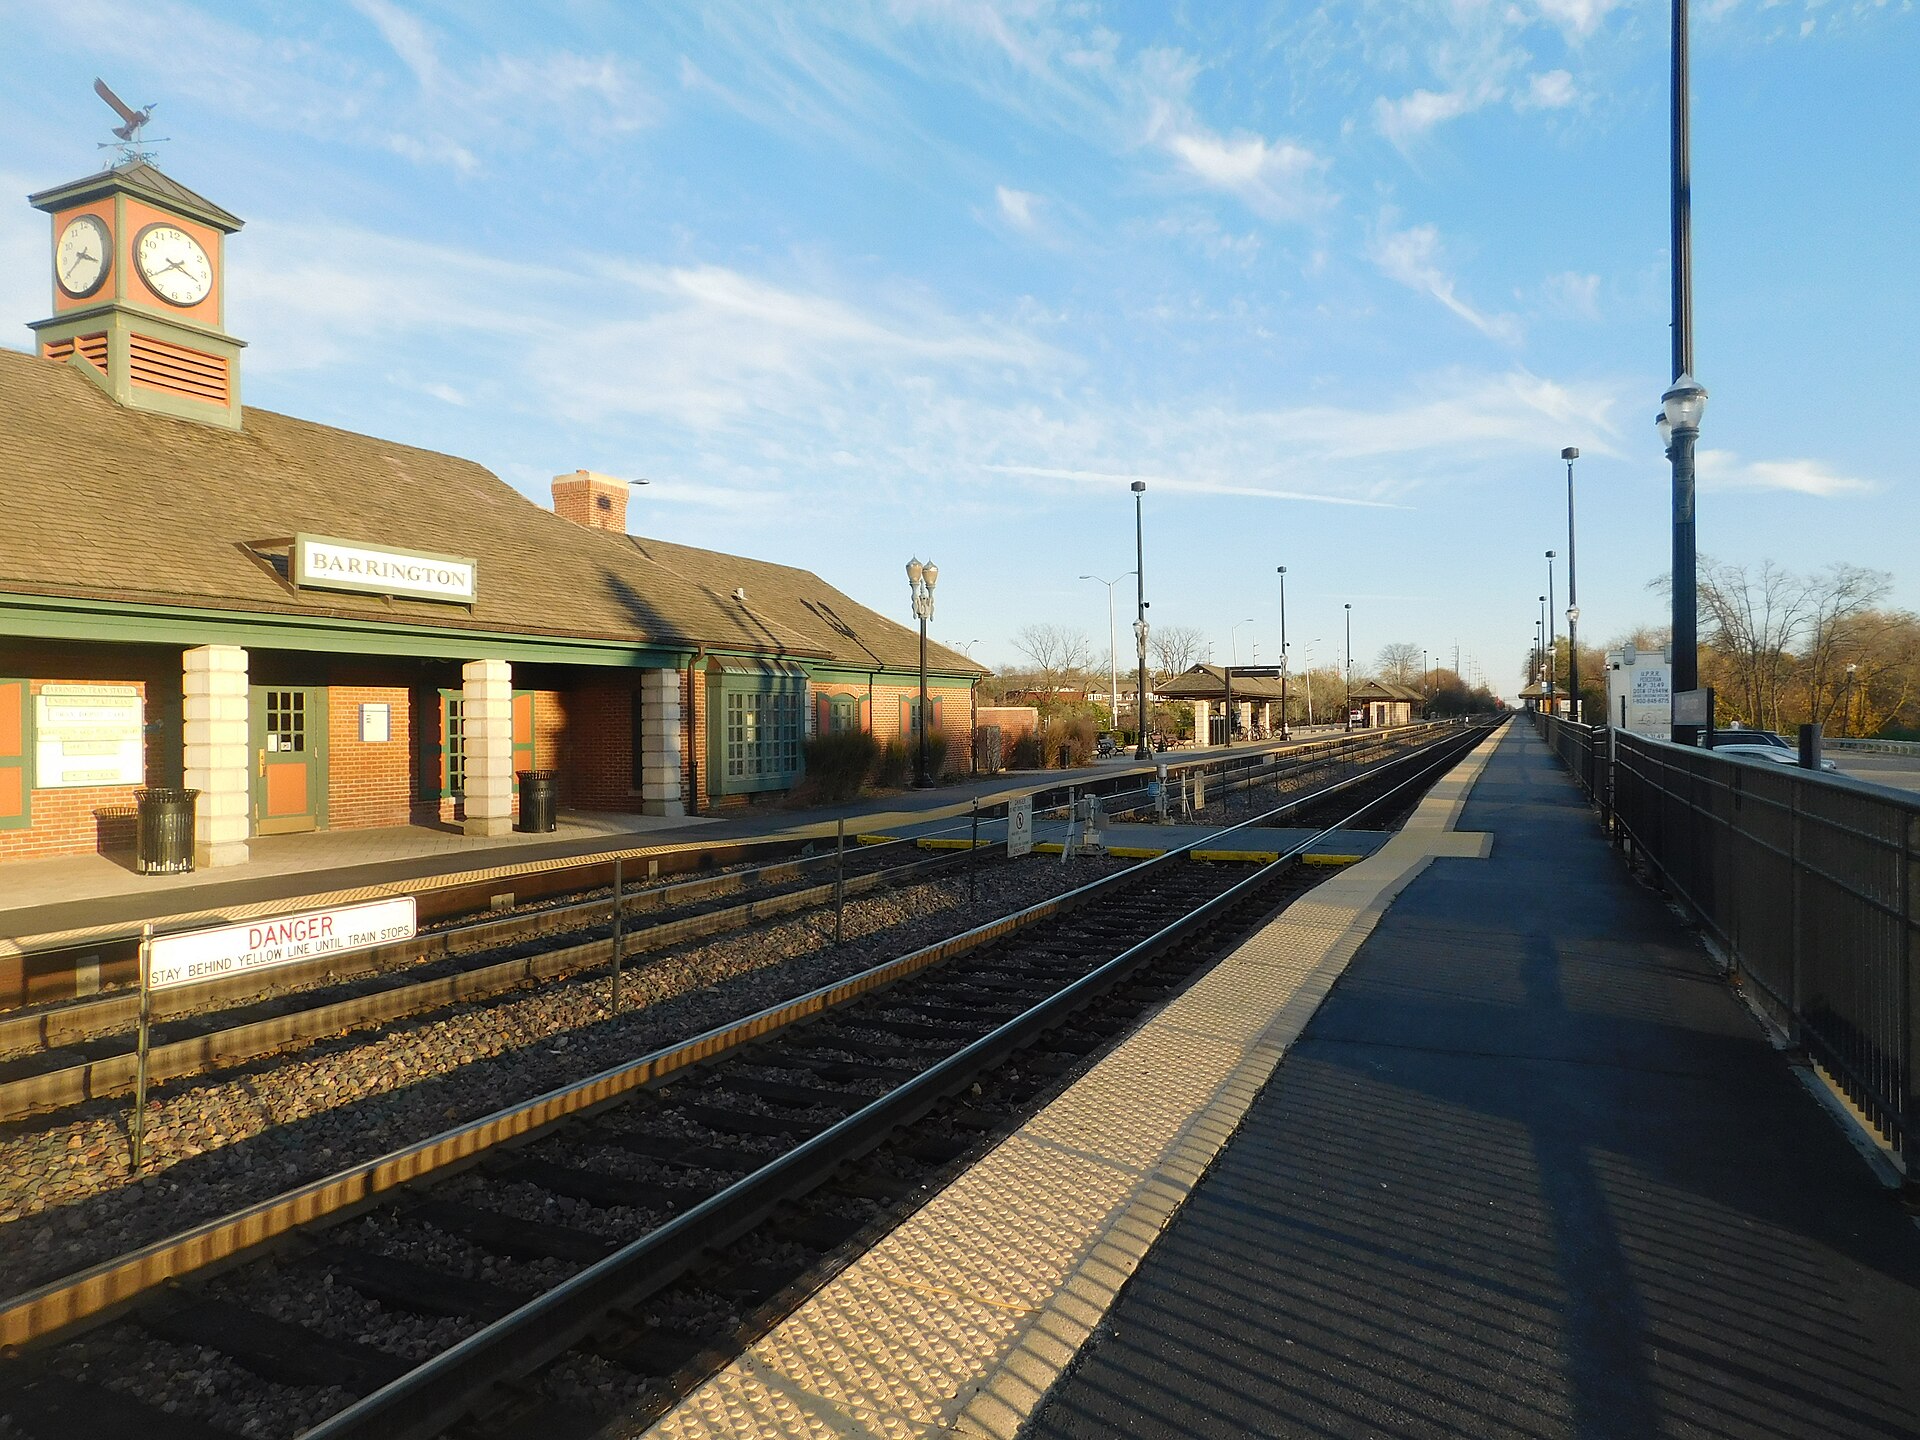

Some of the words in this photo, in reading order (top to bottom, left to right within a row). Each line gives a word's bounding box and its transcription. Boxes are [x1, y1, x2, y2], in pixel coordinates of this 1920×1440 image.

[72, 230, 78, 238] 11
[155, 232, 165, 240] 11
[169, 230, 180, 240] 12
[65, 242, 73, 251] 10
[145, 240, 156, 249] 10
[146, 268, 154, 278] 8
[201, 271, 206, 279] 3
[172, 292, 178, 300] 6
[312, 552, 465, 587] BARRINGTON
[248, 916, 333, 950] DANGER
[151, 966, 182, 984] STAY
[188, 958, 232, 977] BEHIND
[238, 948, 282, 967] YELLOW
[288, 942, 310, 958] LINE
[316, 938, 343, 952] UNTIL
[348, 932, 376, 946] TRAIN
